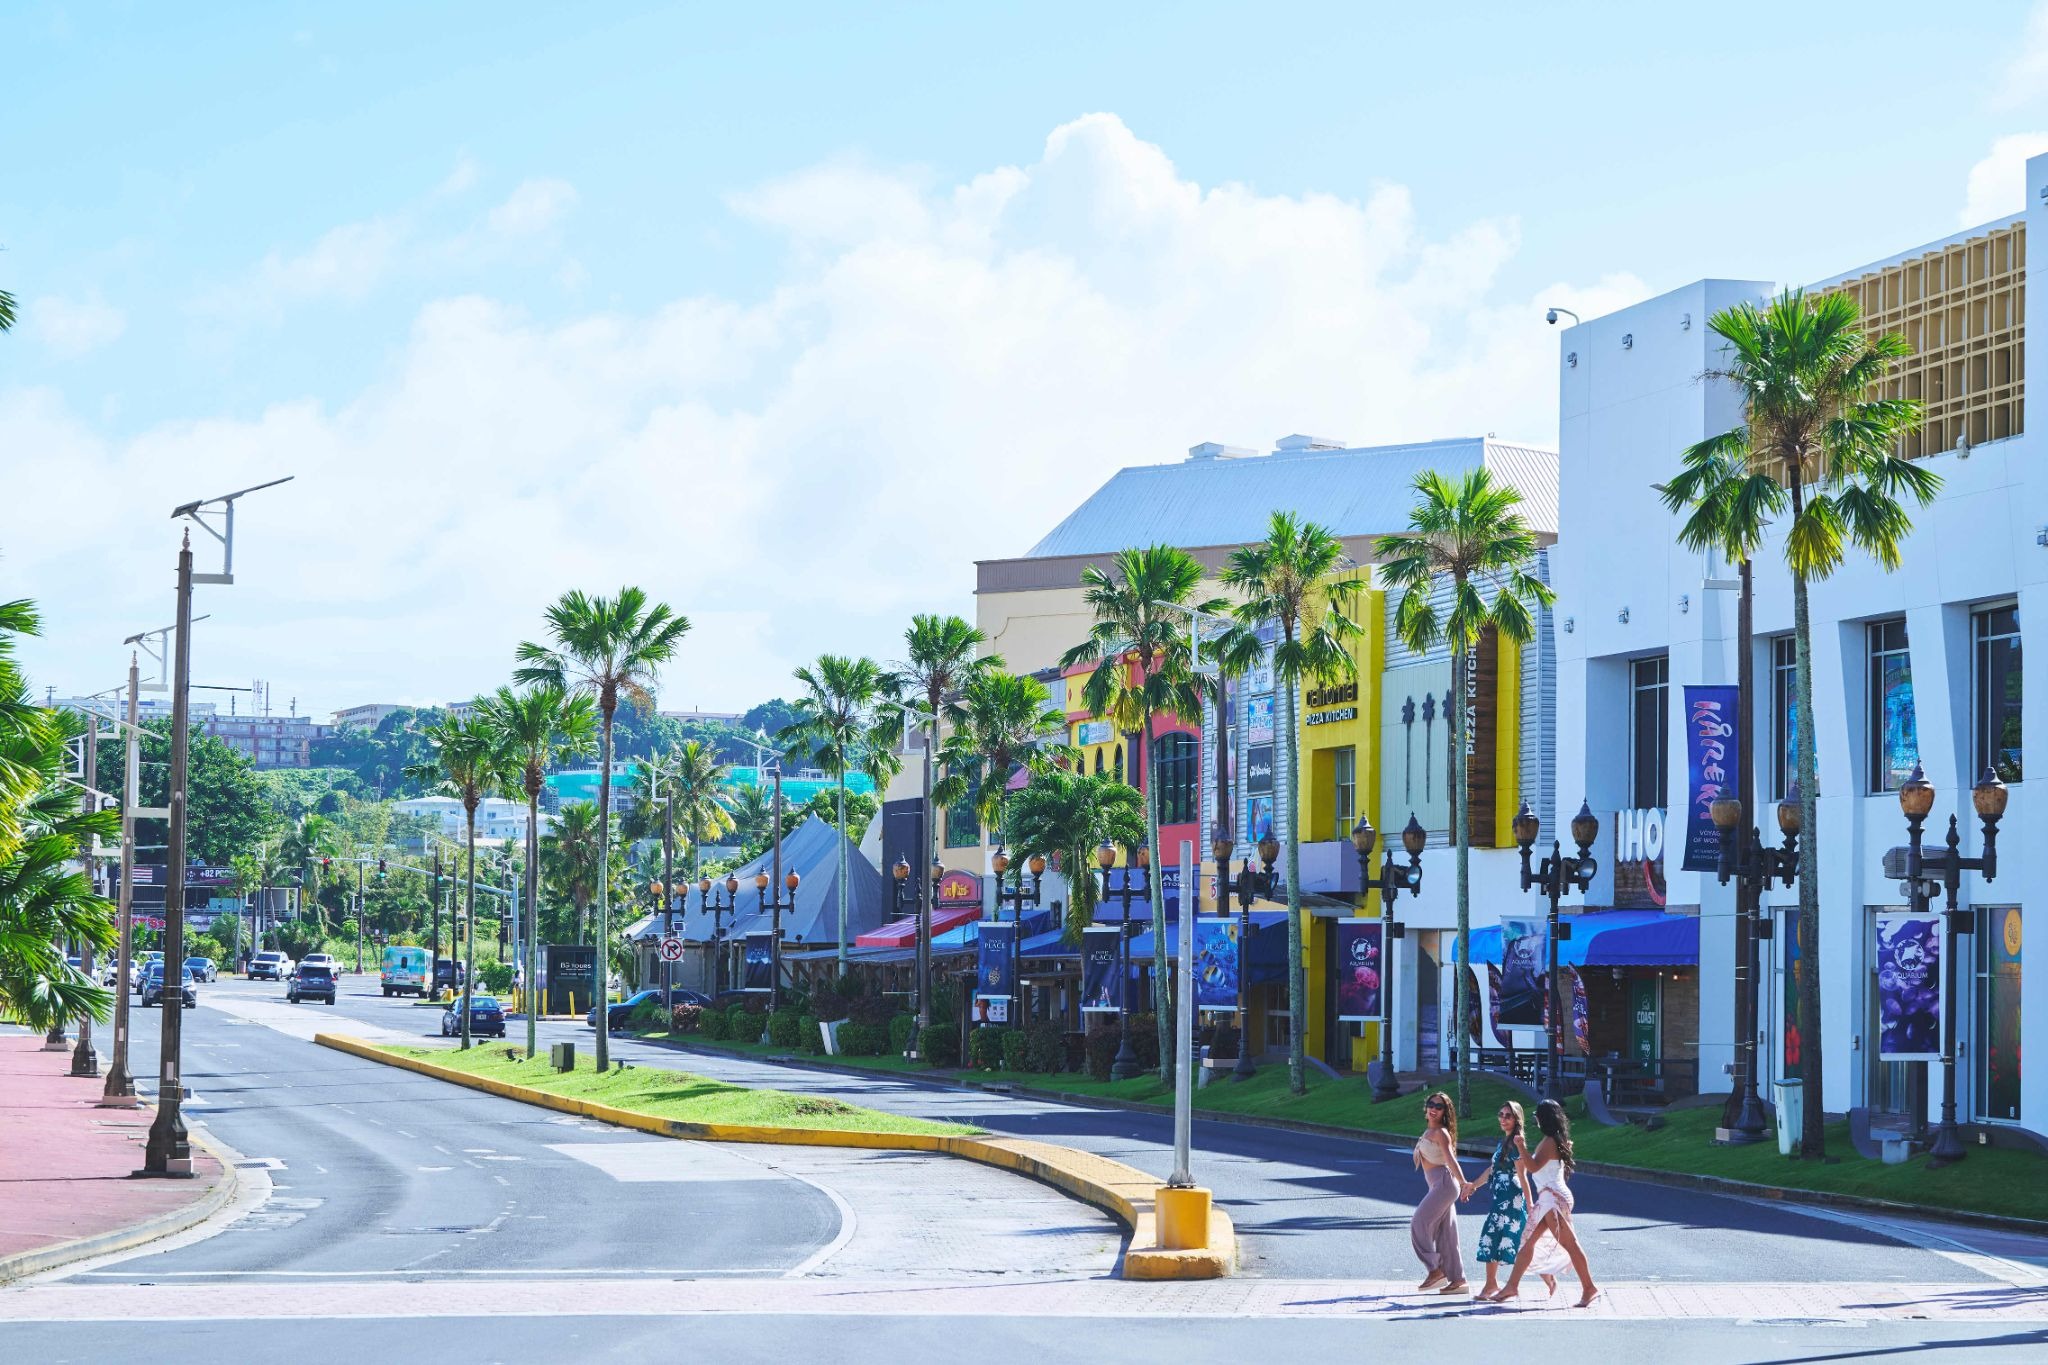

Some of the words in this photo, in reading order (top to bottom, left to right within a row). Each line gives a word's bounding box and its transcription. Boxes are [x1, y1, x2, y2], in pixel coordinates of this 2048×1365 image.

[1306, 713, 1324, 726] PIZZA
[1325, 708, 1353, 723] KITCHEN
[1466, 705, 1476, 755] PIZZA
[1617, 807, 1664, 862] IHO
[1636, 1011, 1655, 1025] COAST
